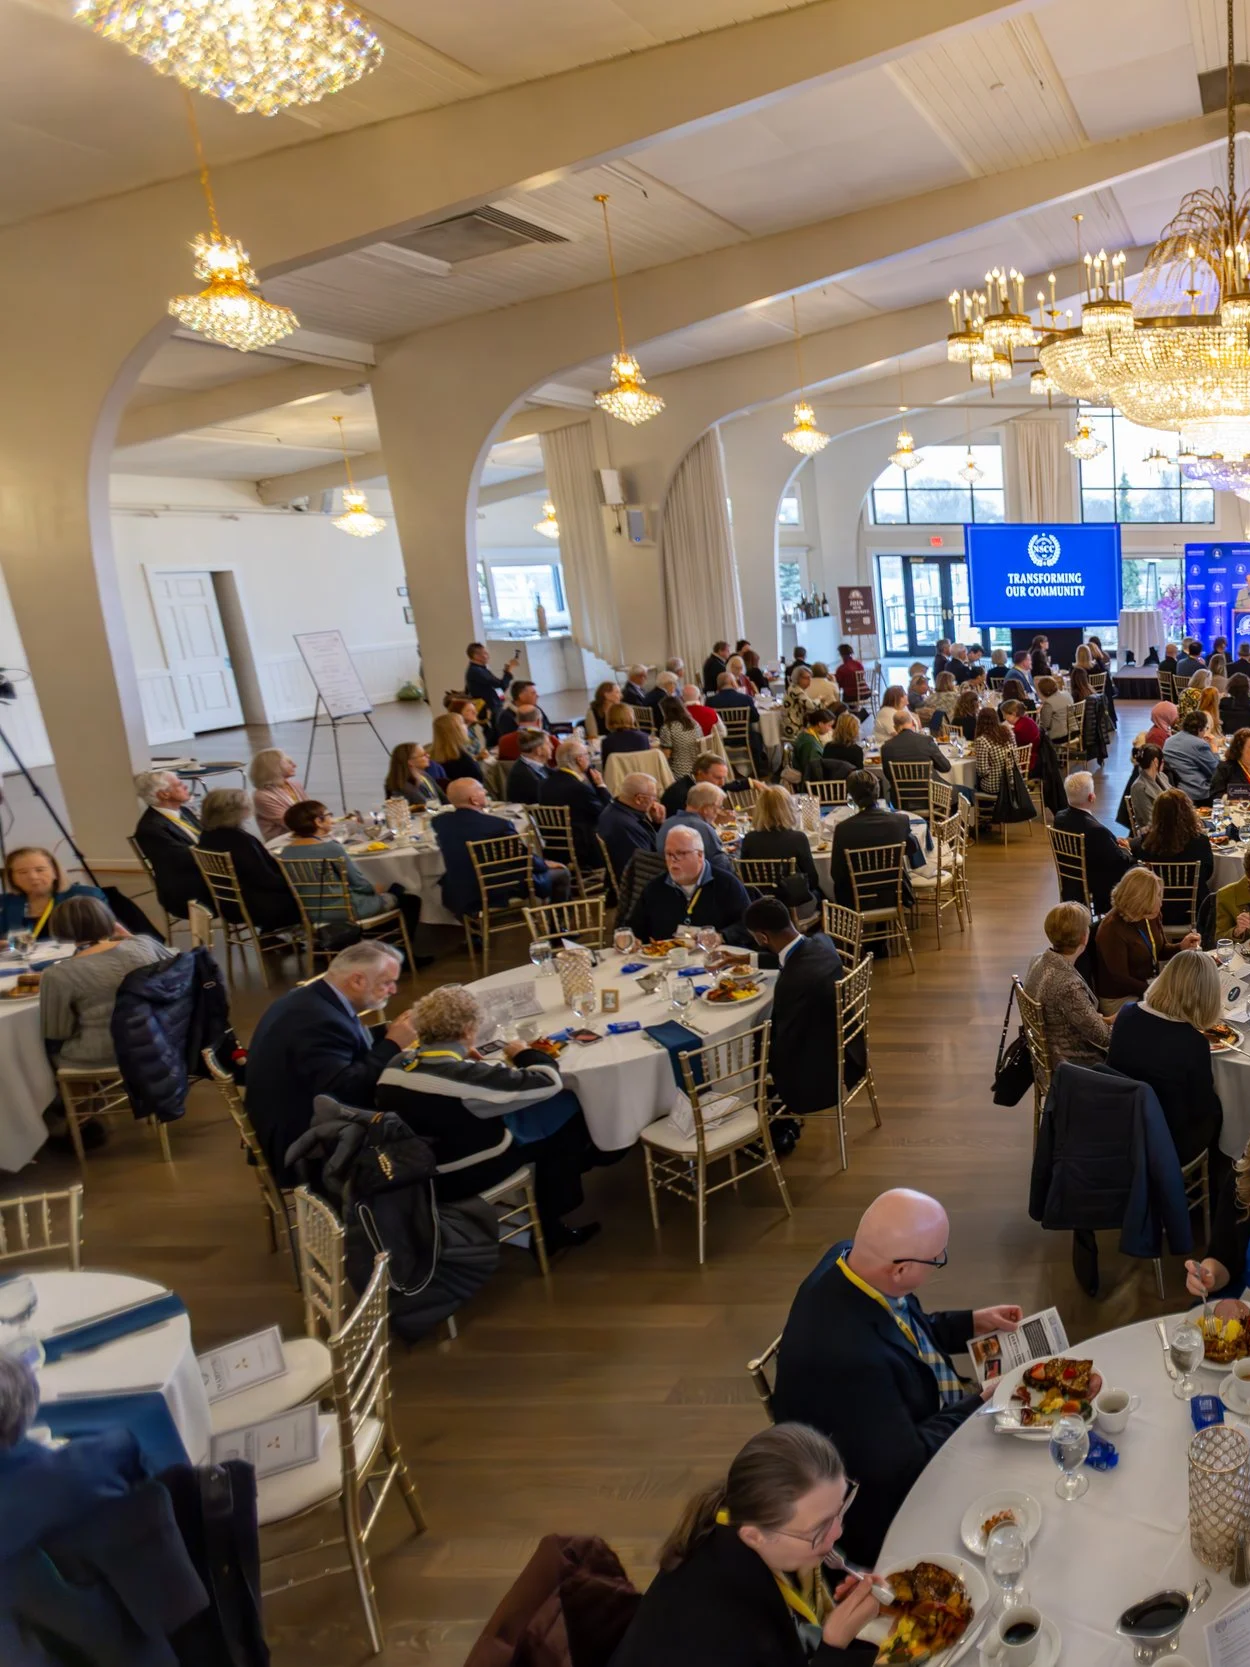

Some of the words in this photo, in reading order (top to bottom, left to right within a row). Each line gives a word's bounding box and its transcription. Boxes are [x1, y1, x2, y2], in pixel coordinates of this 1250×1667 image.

[1007, 572, 1082, 584] TRANSFORMING
[1005, 586, 1026, 597] OUR
[1027, 585, 1085, 597] COMMUNITY
